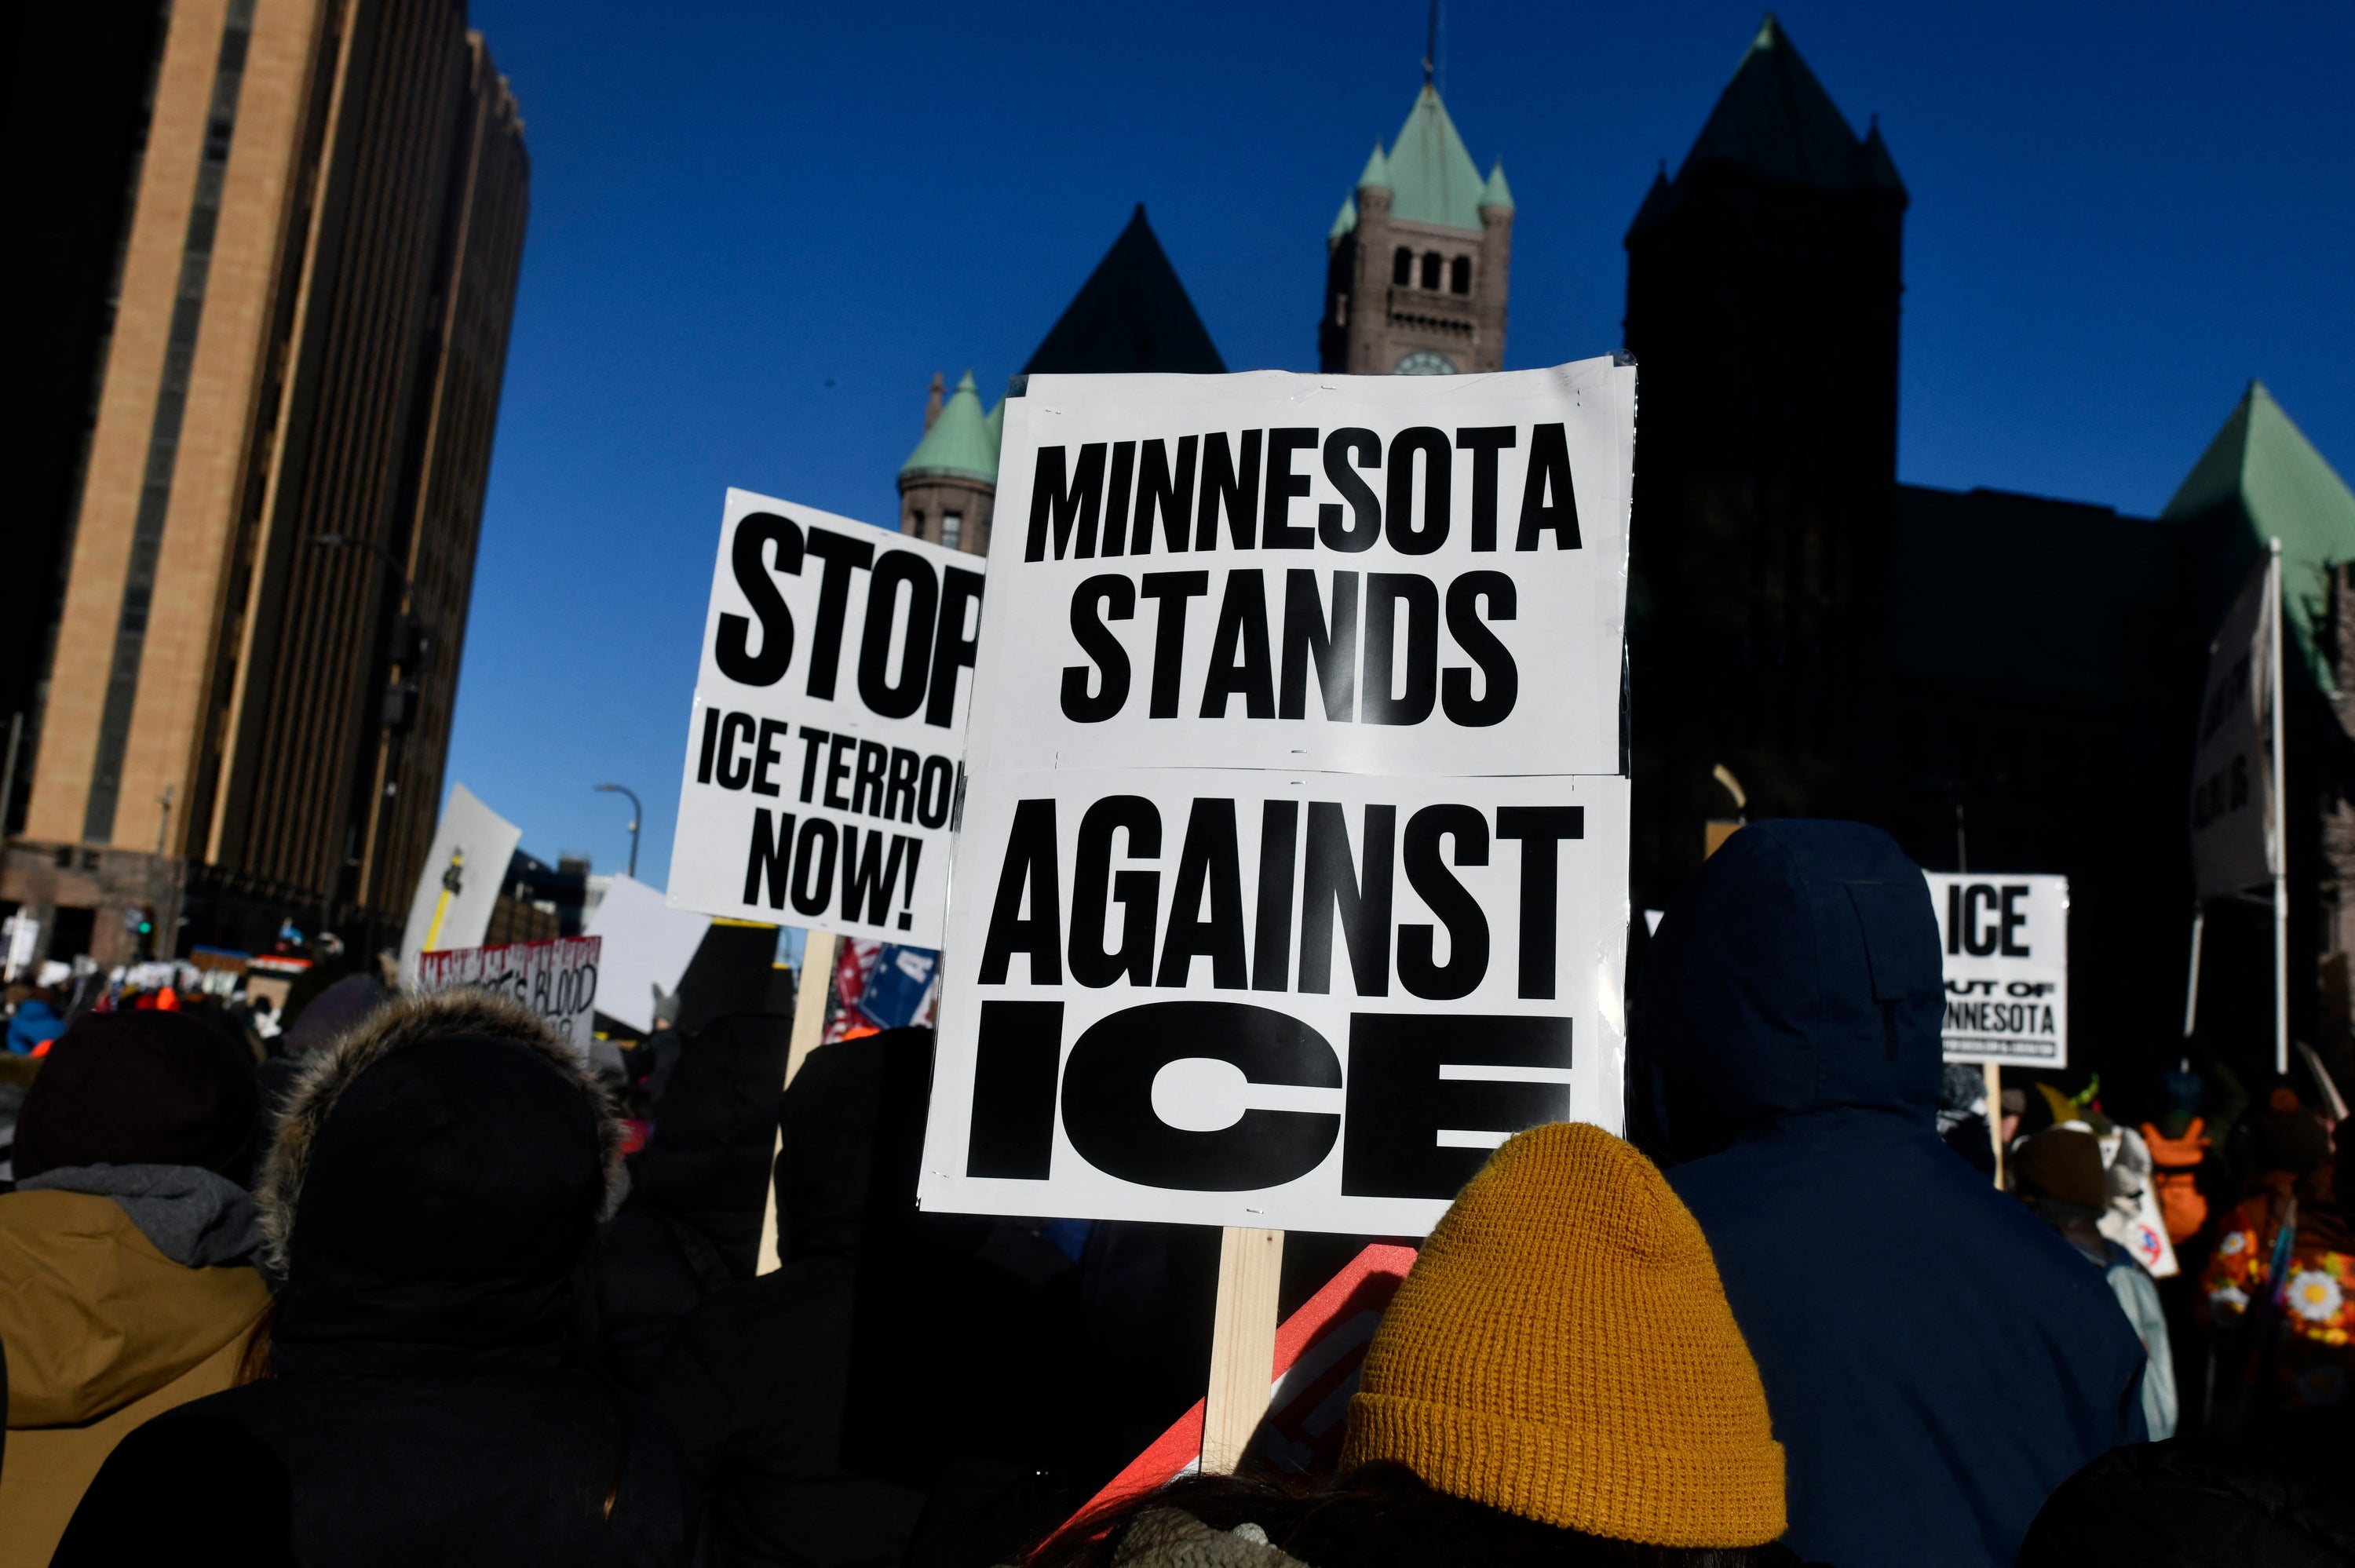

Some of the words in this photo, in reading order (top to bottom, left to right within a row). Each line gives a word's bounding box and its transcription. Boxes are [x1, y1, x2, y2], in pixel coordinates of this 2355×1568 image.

[1024, 421, 1583, 563] MINNESOTA
[715, 512, 985, 729] STOP
[1060, 567, 1518, 727] STANDS
[697, 706, 788, 798] ICE
[798, 725, 964, 832] TERRO
[743, 807, 923, 932] NOW!
[977, 795, 1584, 1001] AGAINST
[1947, 884, 2031, 957] ICE
[1944, 980, 1999, 996] UT
[2006, 982, 2055, 998] OF
[1947, 1001, 2055, 1034] NNESOTA
[966, 1001, 1573, 1202] ICE
